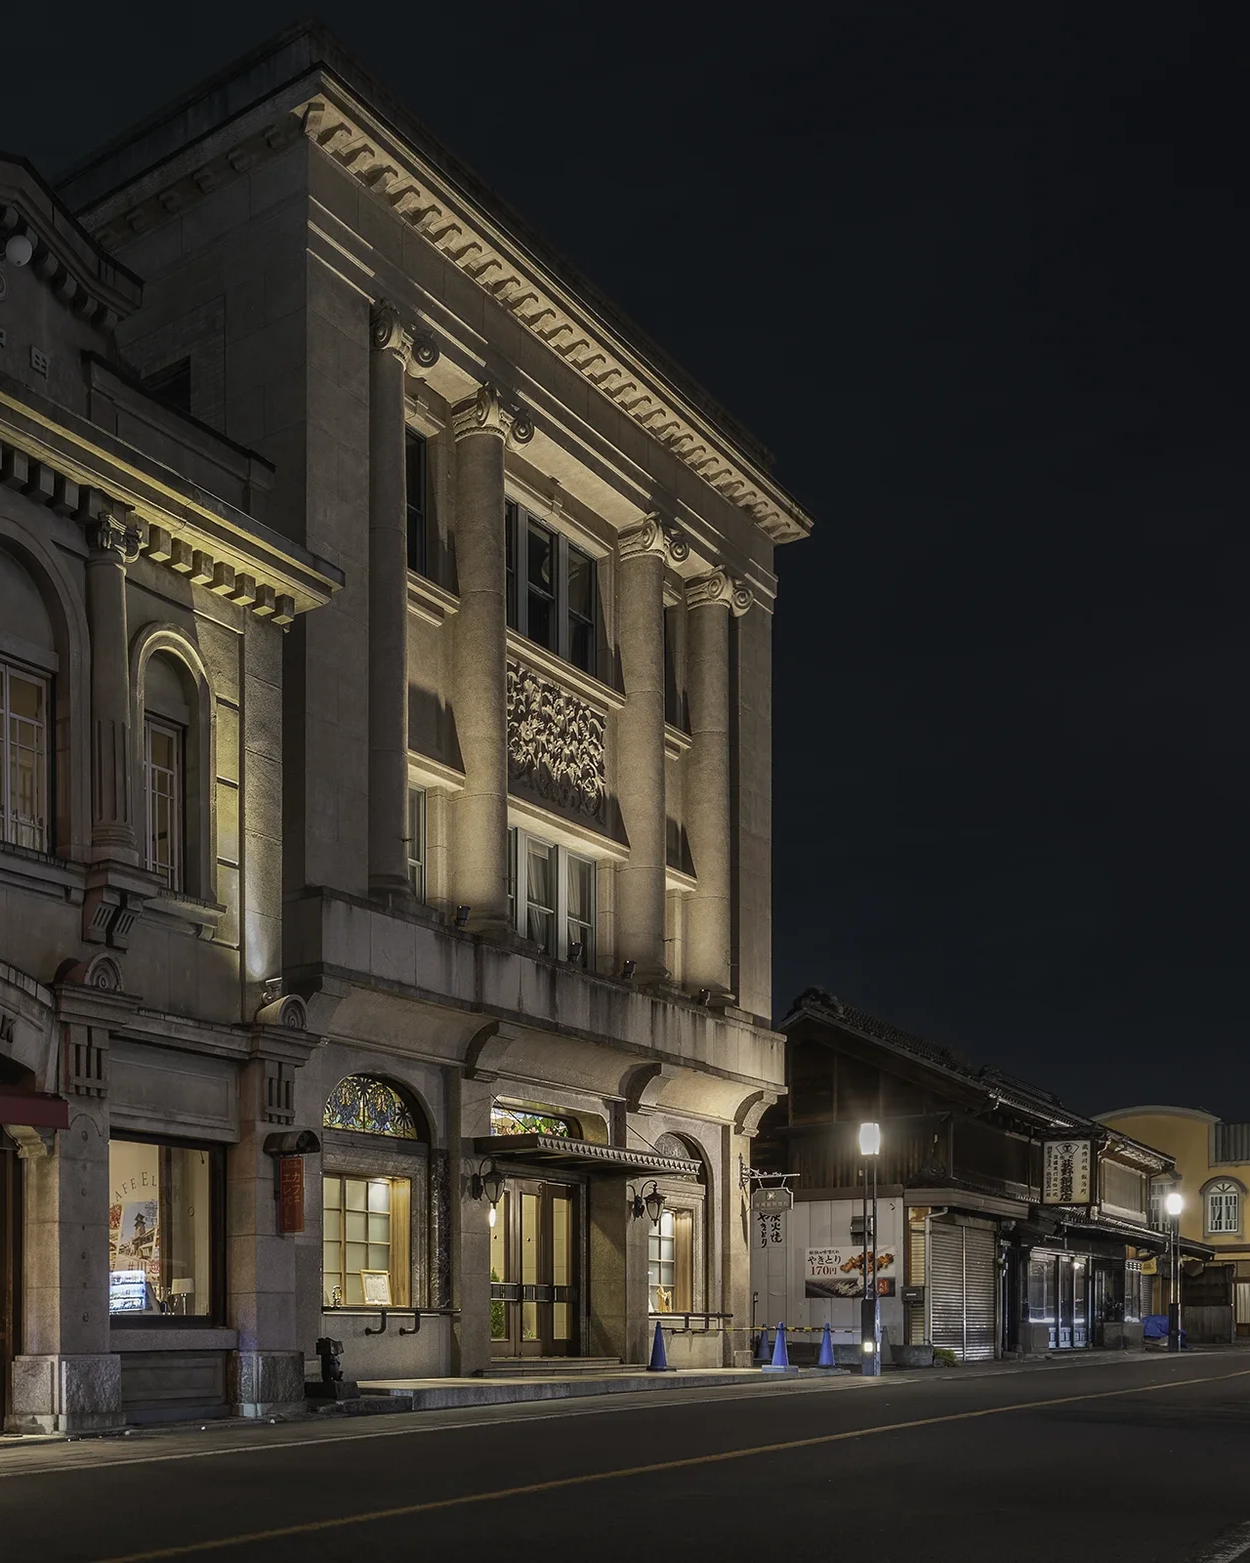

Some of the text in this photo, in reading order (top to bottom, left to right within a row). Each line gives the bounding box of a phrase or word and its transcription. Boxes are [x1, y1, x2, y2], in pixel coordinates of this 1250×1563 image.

[807, 1255, 842, 1265] やきとり
[811, 1266, 837, 1276] 170円
